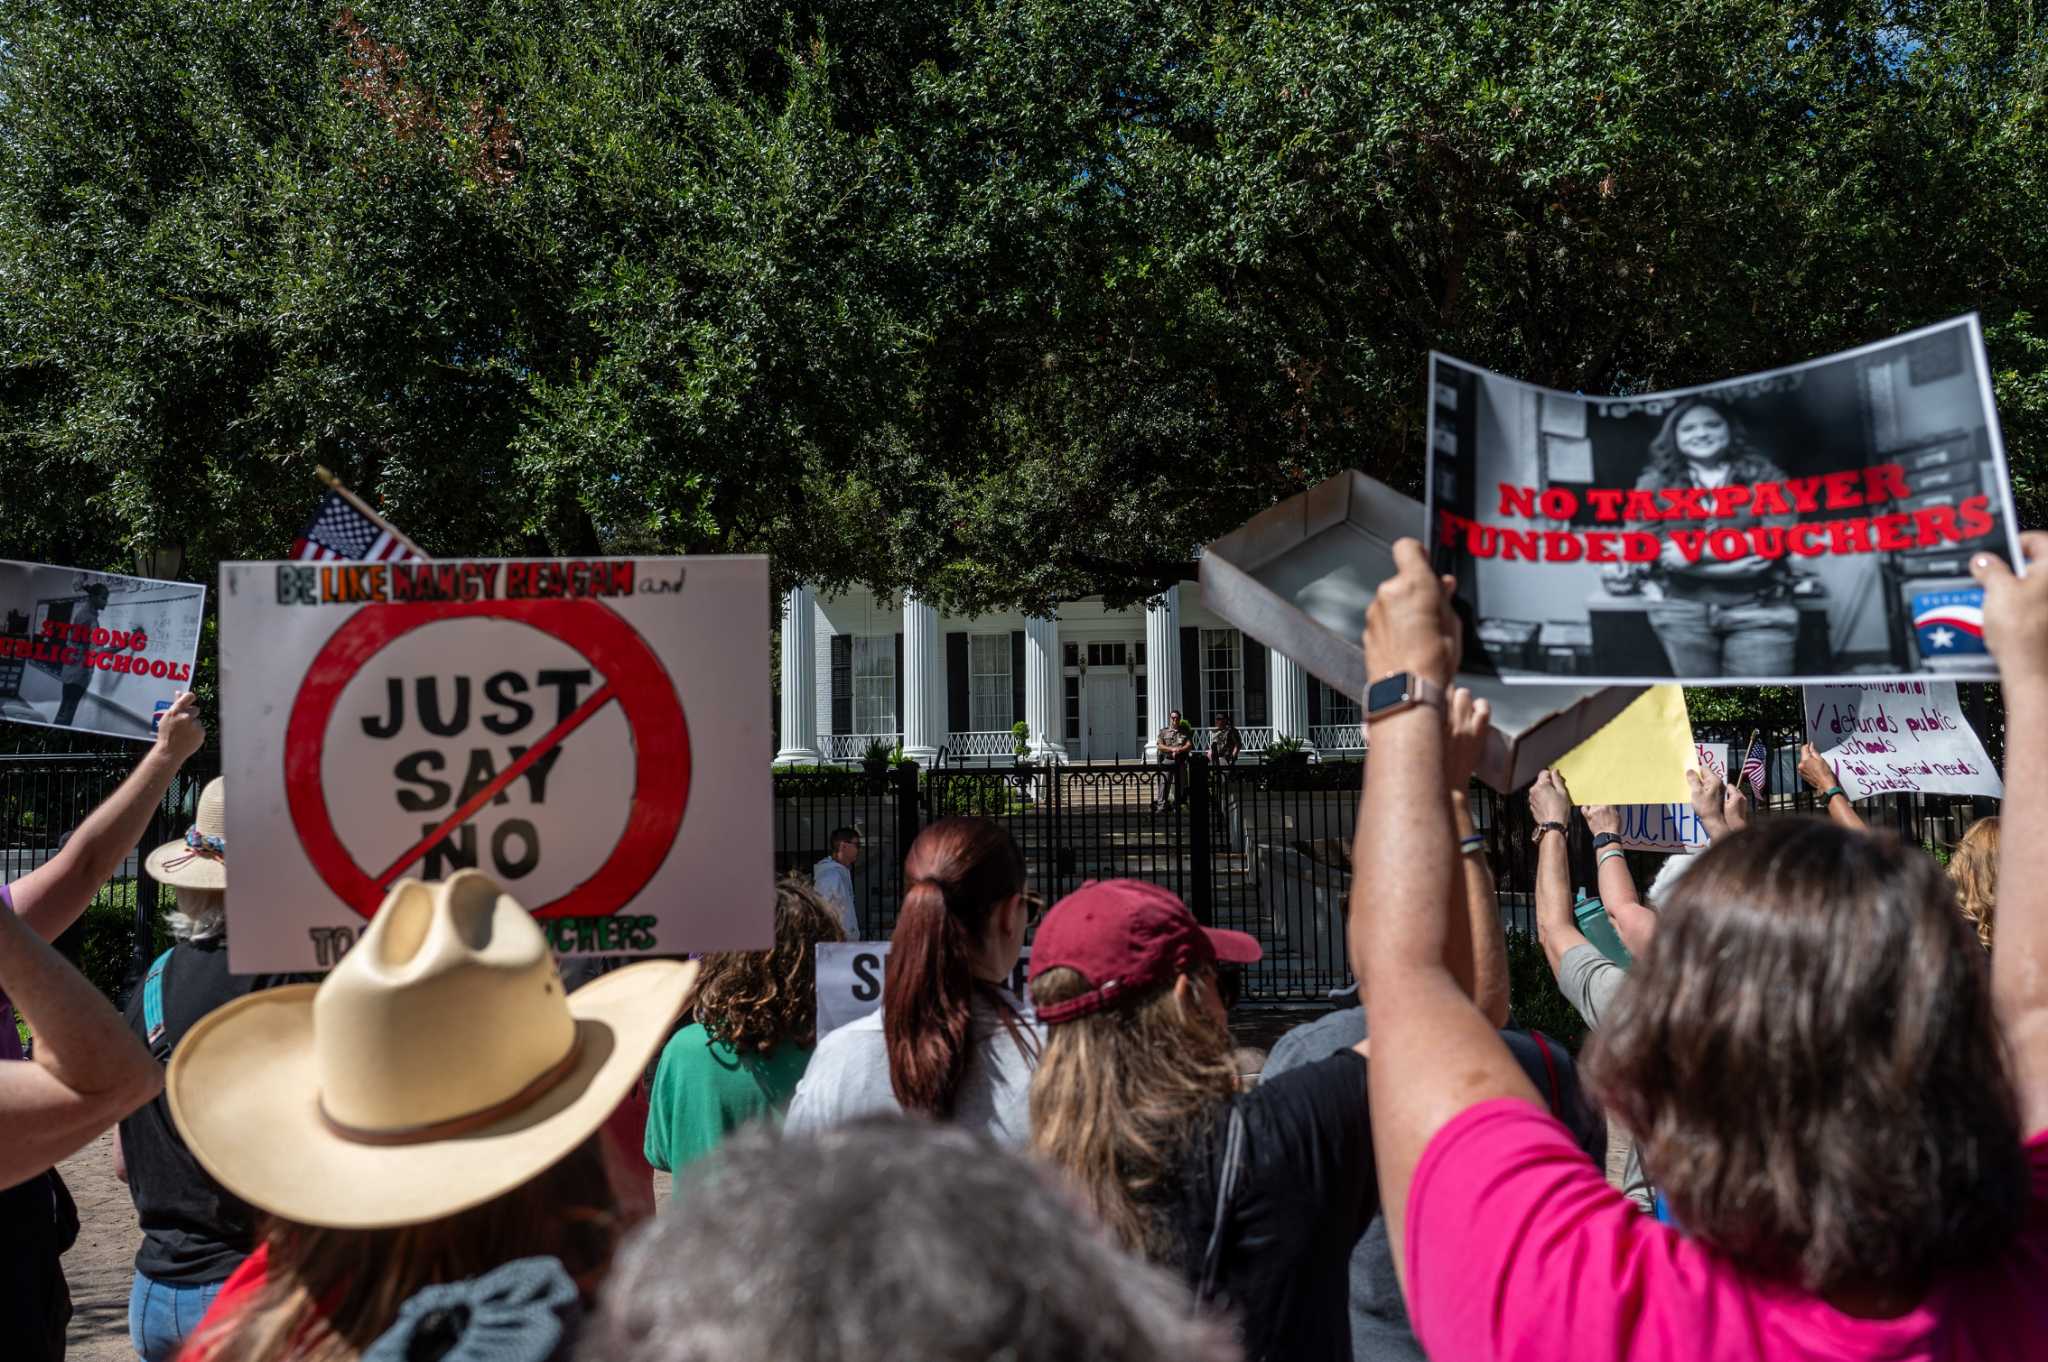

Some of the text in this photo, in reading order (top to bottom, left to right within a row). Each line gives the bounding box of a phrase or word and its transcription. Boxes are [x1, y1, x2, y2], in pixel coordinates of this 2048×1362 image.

[1498, 463, 1912, 522] NO TAXPAYER
[1439, 495, 1994, 566] FUNDED VOUCHERS
[277, 560, 687, 605] BE LIKE NANCY REAGAN and
[42, 620, 148, 653] STRONG
[81, 649, 191, 683] SCHOOLS
[360, 668, 592, 739] JUST
[1830, 703, 1958, 742] defunds public
[393, 746, 563, 813] SAY
[1842, 759, 1881, 777] fails
[1933, 758, 1980, 776] needs
[420, 818, 540, 880] NO
